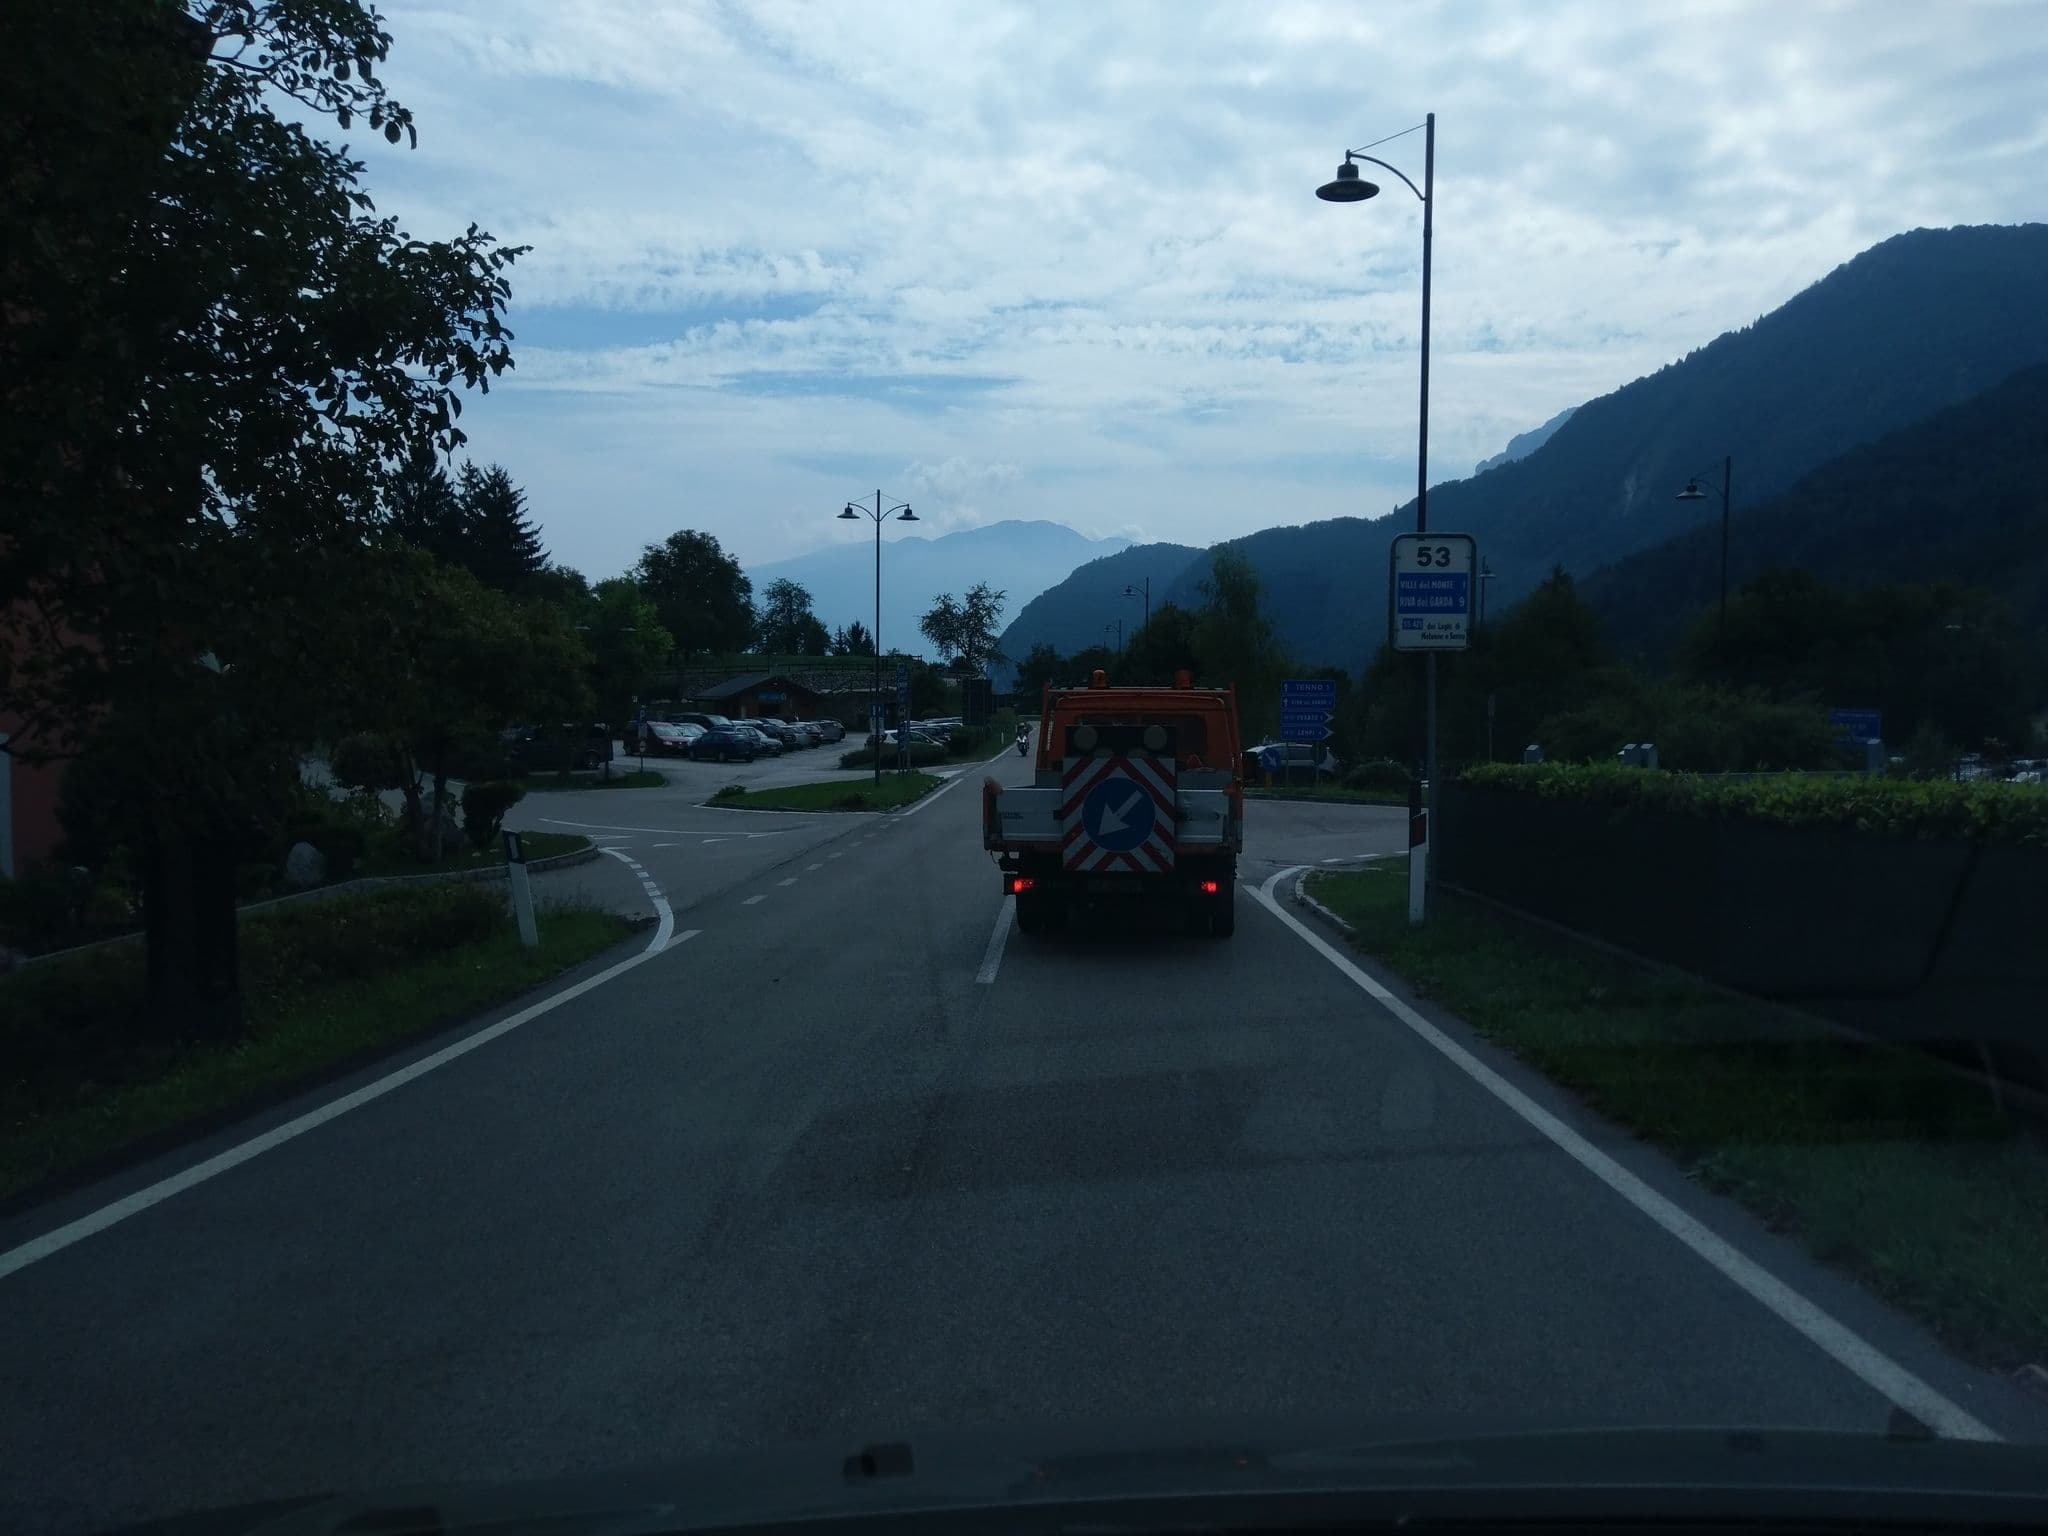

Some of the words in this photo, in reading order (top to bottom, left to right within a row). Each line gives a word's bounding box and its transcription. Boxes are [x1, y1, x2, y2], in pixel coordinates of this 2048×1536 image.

[1417, 547, 1450, 567] 53
[1400, 580, 1417, 590] VILLE
[1418, 580, 1431, 590] del
[1431, 580, 1454, 590] MONTE
[1399, 596, 1416, 607] RIVA
[1416, 596, 1428, 607] del
[1429, 596, 1454, 607] GARDA
[1458, 596, 1466, 607] 9
[1295, 683, 1324, 691] TENNO
